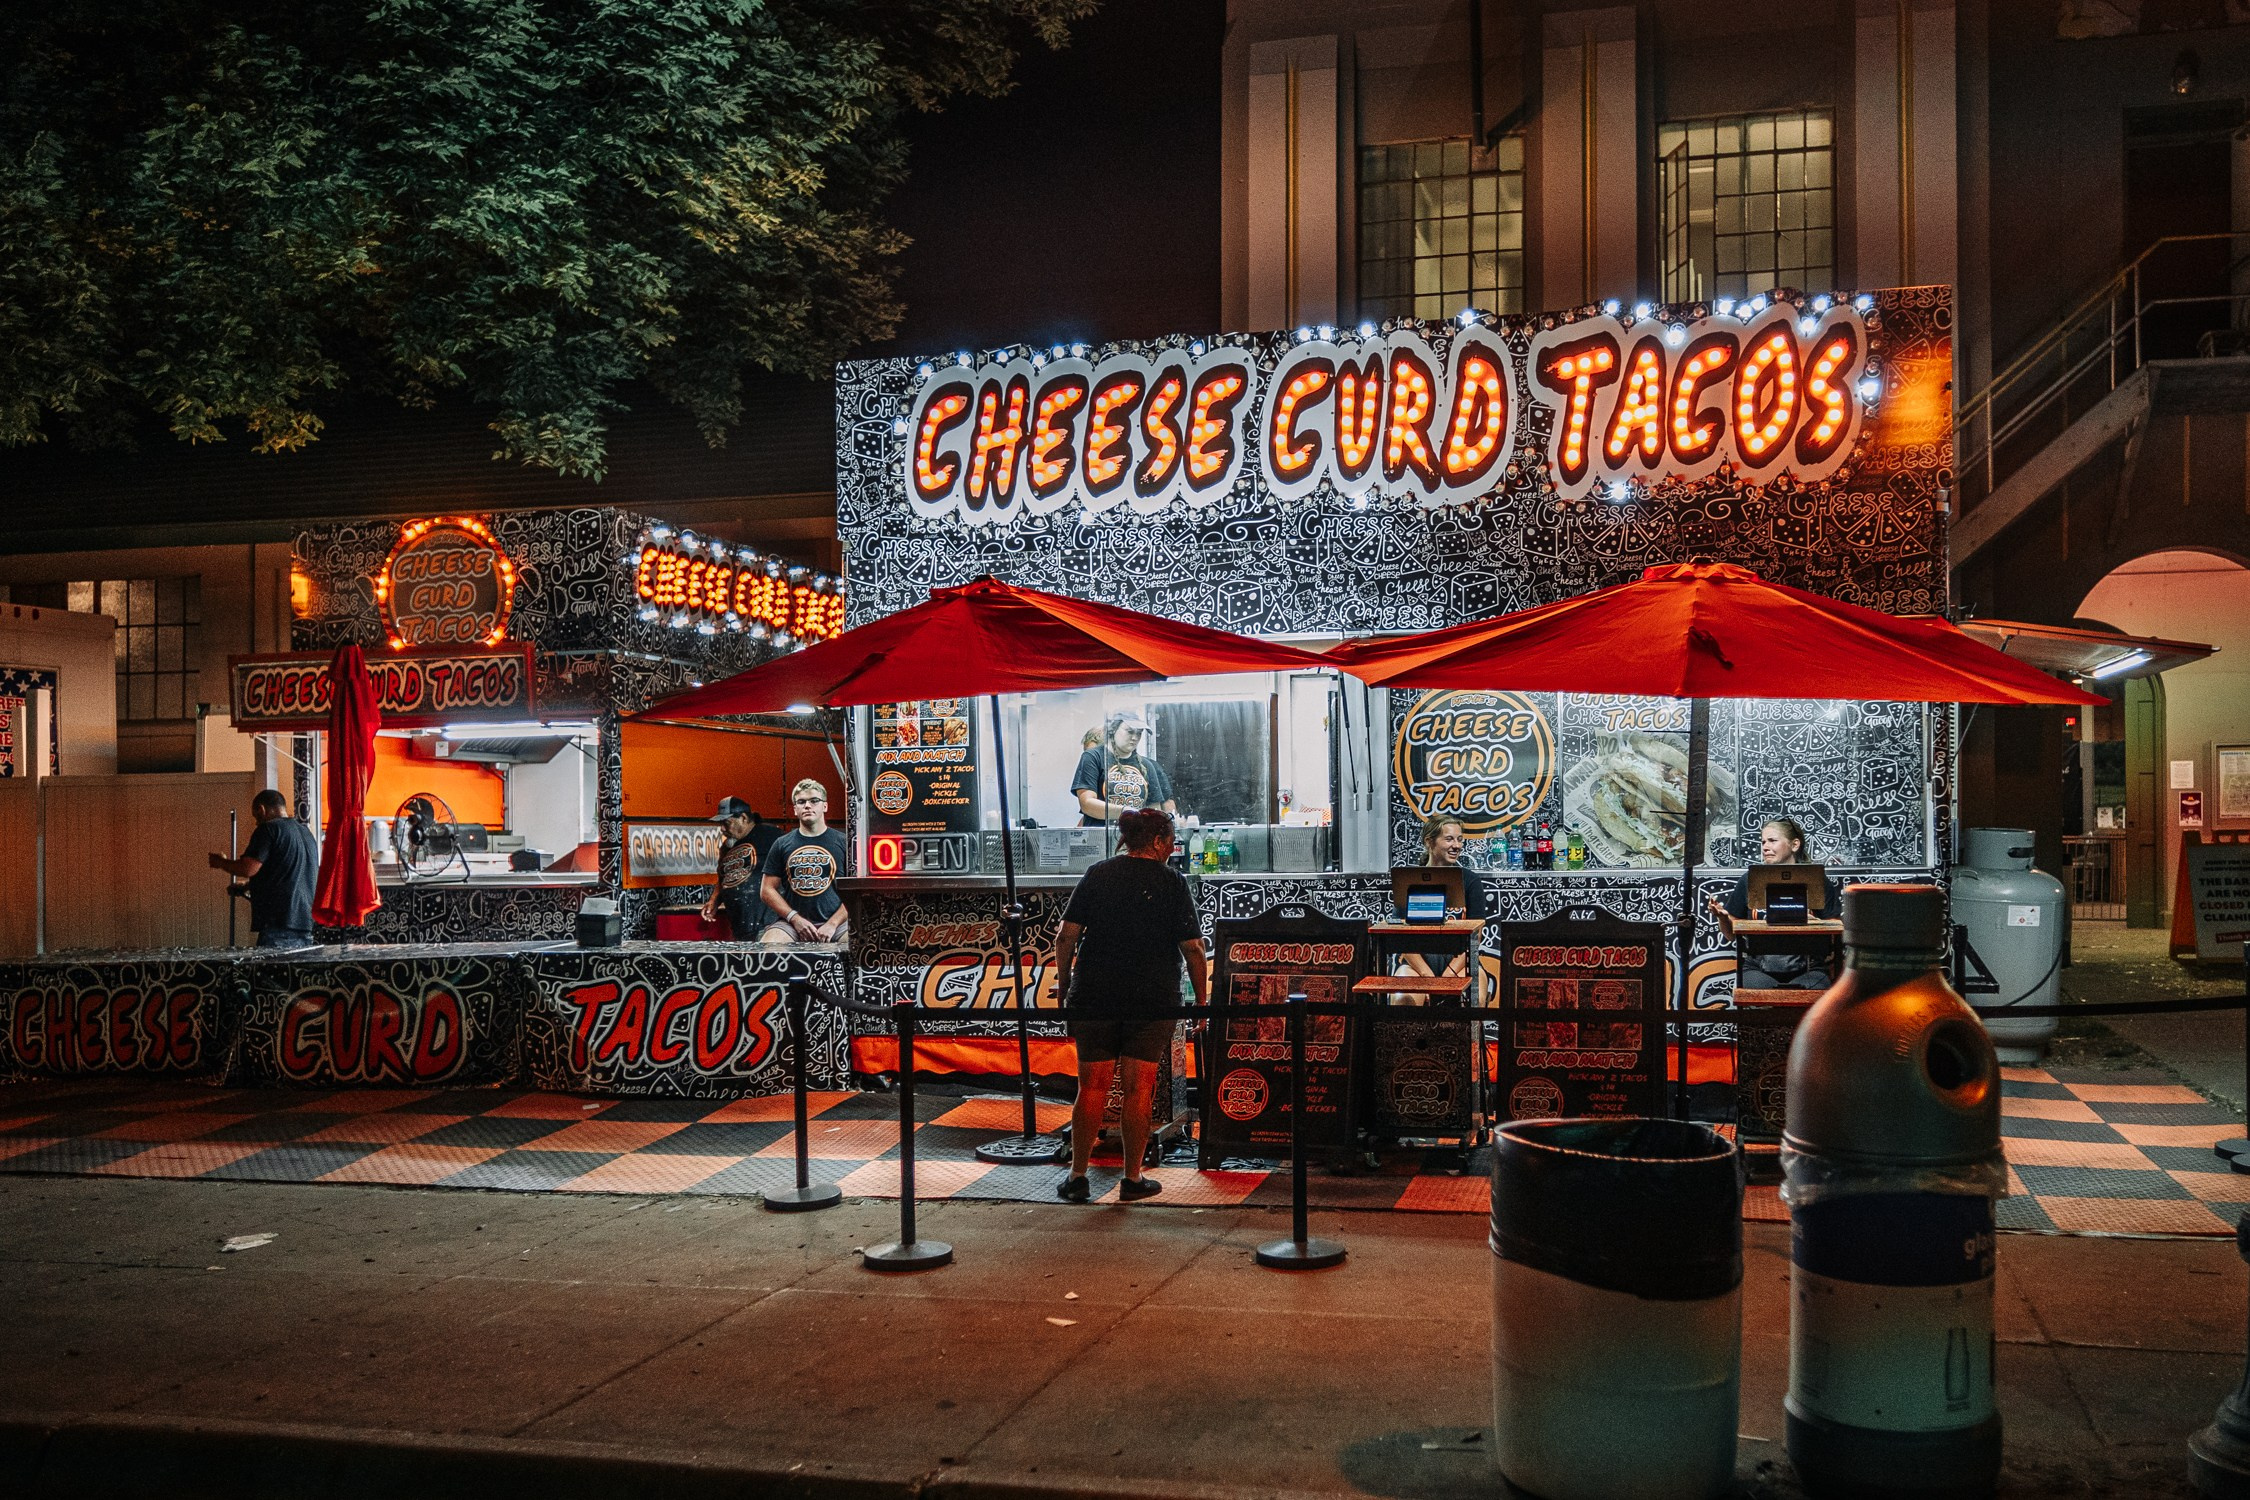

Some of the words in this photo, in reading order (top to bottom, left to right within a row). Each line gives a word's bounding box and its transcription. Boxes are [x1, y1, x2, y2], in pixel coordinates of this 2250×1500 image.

[912, 358, 1253, 512] CHEESE
[1268, 344, 1508, 494] CURD
[1541, 317, 1857, 487] TACOS
[1787, 491, 1894, 517] CHEESE
[1300, 508, 1396, 539] CHEESE
[860, 531, 948, 560] CHEESE
[1073, 527, 1165, 550] CHEESE
[393, 548, 495, 583] CHEESE
[1193, 562, 1245, 582] Cheese
[1426, 555, 1480, 573] Cheese
[410, 580, 477, 611] CURD
[735, 565, 789, 628] CURD
[396, 612, 495, 647] TACOS
[247, 668, 332, 714] CHEES
[369, 661, 424, 711] URD
[427, 657, 519, 711] TACOS
[1739, 698, 1814, 721] CHEESE
[1406, 709, 1537, 746] CHEESE
[1601, 707, 1688, 733] TACOS
[876, 750, 898, 764] MIX
[898, 750, 921, 763] AND
[921, 749, 966, 763] MATCH
[1427, 744, 1513, 781] CURD
[953, 765, 975, 773] TACOS
[875, 779, 908, 789] CHEESE
[880, 788, 903, 798] CURD
[1114, 784, 1141, 795] CURD
[1777, 776, 1858, 800] CHEESE
[876, 799, 909, 809] TACOS
[1410, 782, 1537, 818] TACOS
[788, 855, 830, 867] CHEESE
[872, 836, 965, 871] OPEN
[794, 866, 823, 877] CURD
[1616, 876, 1646, 885] CHEESE
[791, 877, 829, 890] TACOS
[2199, 878, 2222, 886] THE
[2206, 889, 2231, 897] ARE
[2199, 902, 2245, 910] CLOSED
[501, 904, 577, 933] CHEESE
[1229, 943, 1278, 962] CHEESE
[1278, 944, 1313, 964] CURD
[1310, 943, 1354, 965] TACOS
[1513, 946, 1564, 967] CHEESE
[1564, 946, 1602, 968] CURD
[1602, 946, 1648, 969] TACOS
[12, 984, 202, 1072] CHEESE
[278, 978, 466, 1082] CURD
[554, 977, 784, 1075] TACOS
[1228, 1043, 1253, 1060] MIX
[1253, 1044, 1287, 1061] AND
[1517, 1051, 1548, 1068] MIX
[1547, 1052, 1579, 1068] AND
[1578, 1052, 1638, 1069] MATCH
[1223, 1078, 1264, 1090] CHEESE
[1393, 1069, 1449, 1083] CHEESE
[1620, 1074, 1648, 1082] TACOS
[1228, 1090, 1257, 1101] CURD
[1402, 1084, 1439, 1099] CURD
[1514, 1087, 1559, 1098] CHEESE
[1223, 1101, 1262, 1113] TACOS
[1395, 1100, 1449, 1115] TACOS
[1520, 1099, 1550, 1110] CURD
